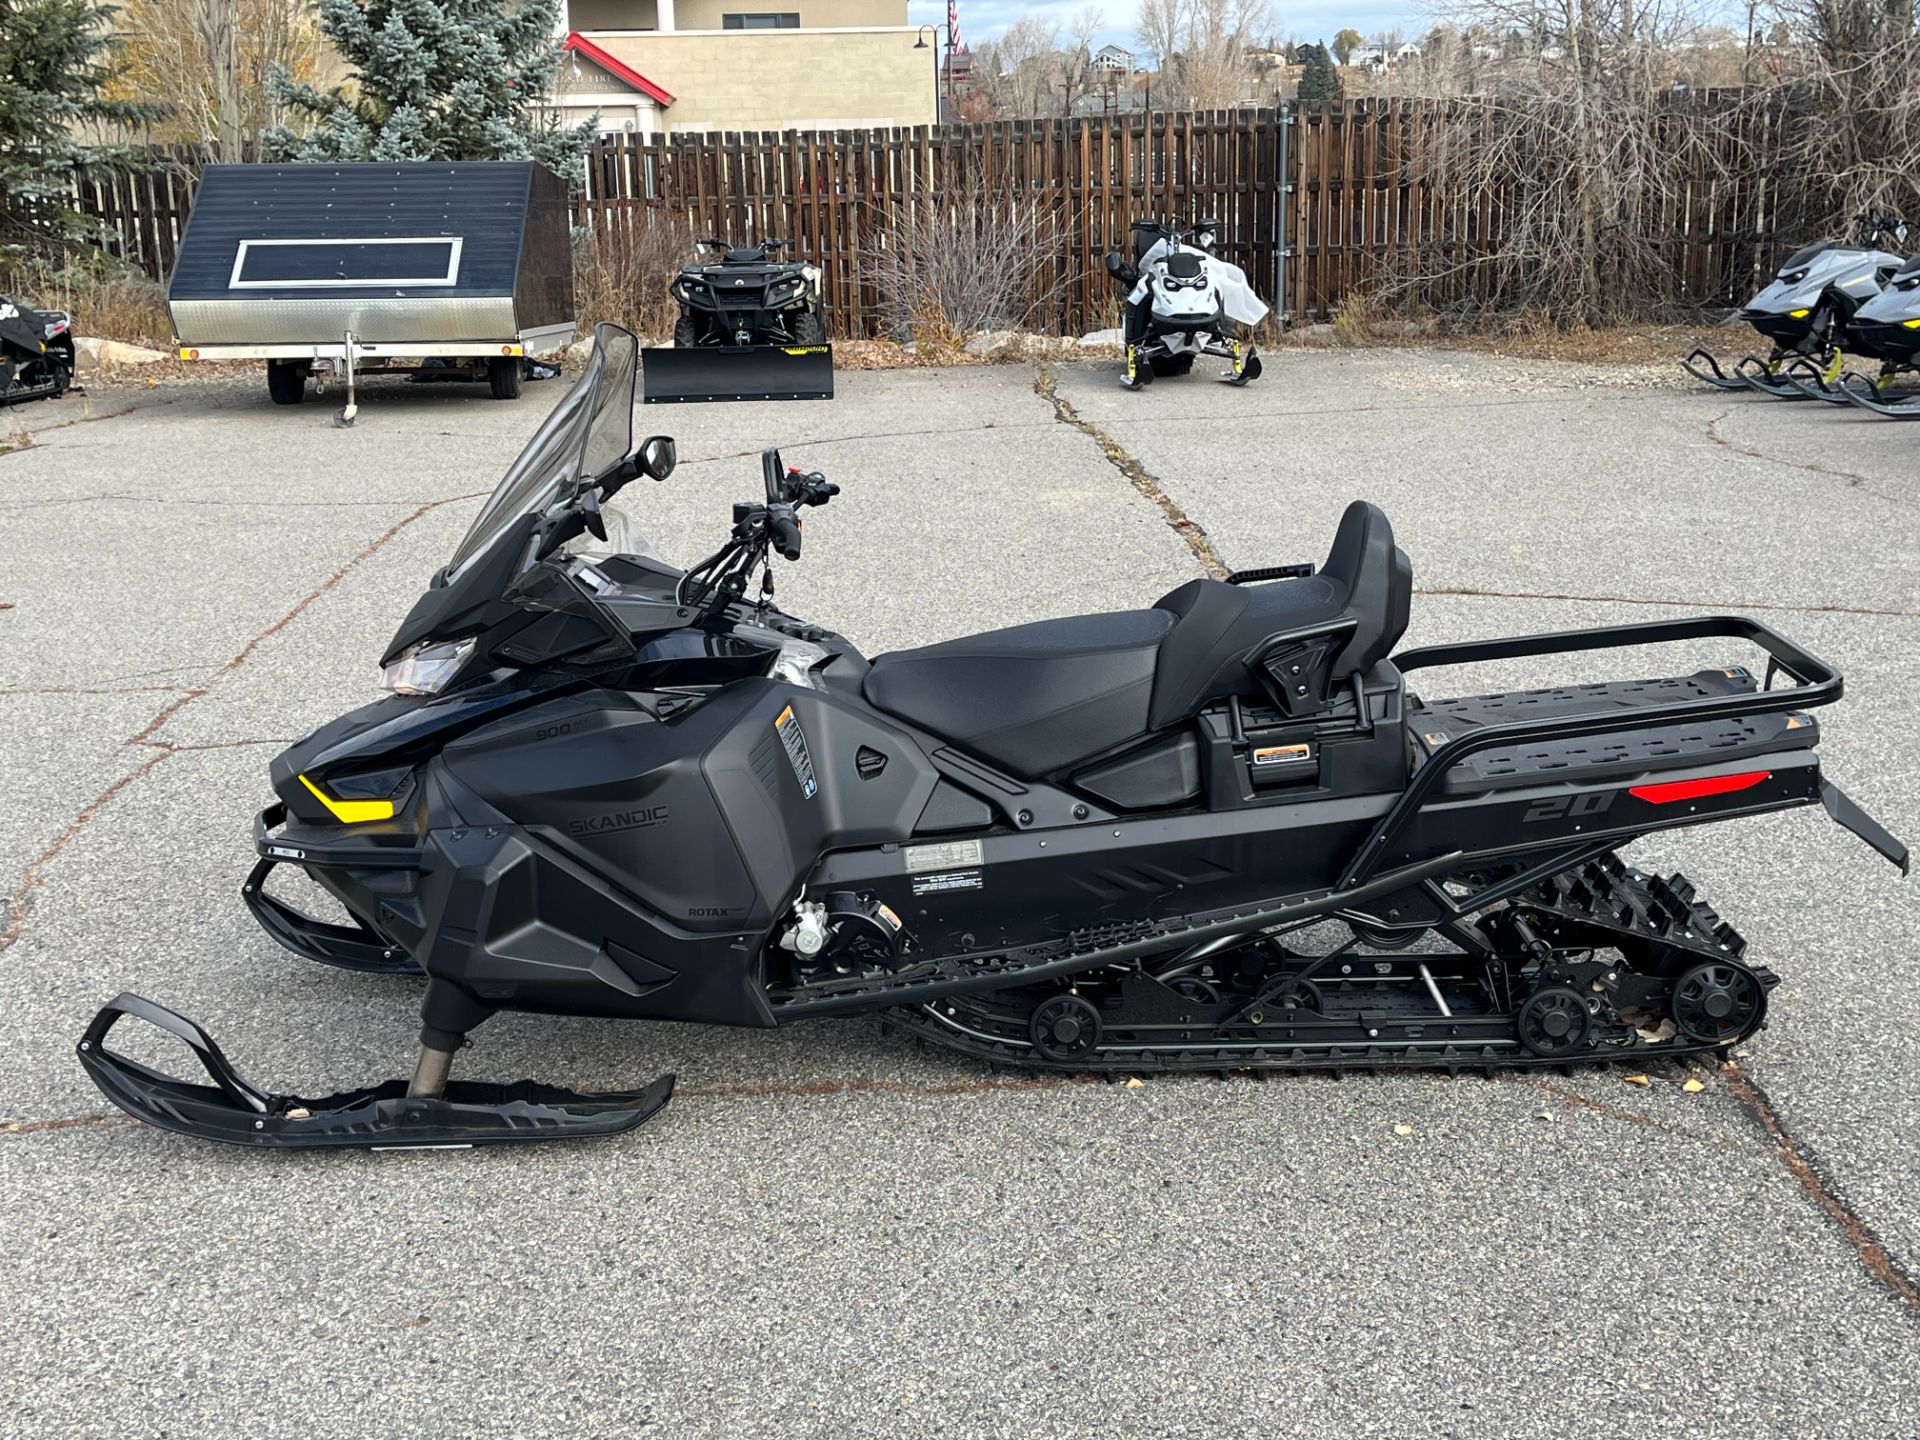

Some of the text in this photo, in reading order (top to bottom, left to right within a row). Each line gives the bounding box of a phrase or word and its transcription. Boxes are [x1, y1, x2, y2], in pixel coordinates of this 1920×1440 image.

[536, 723, 570, 741] 900
[1522, 790, 1618, 823] 20
[569, 805, 669, 834] SKANDIC
[688, 908, 728, 917] ROTAX
